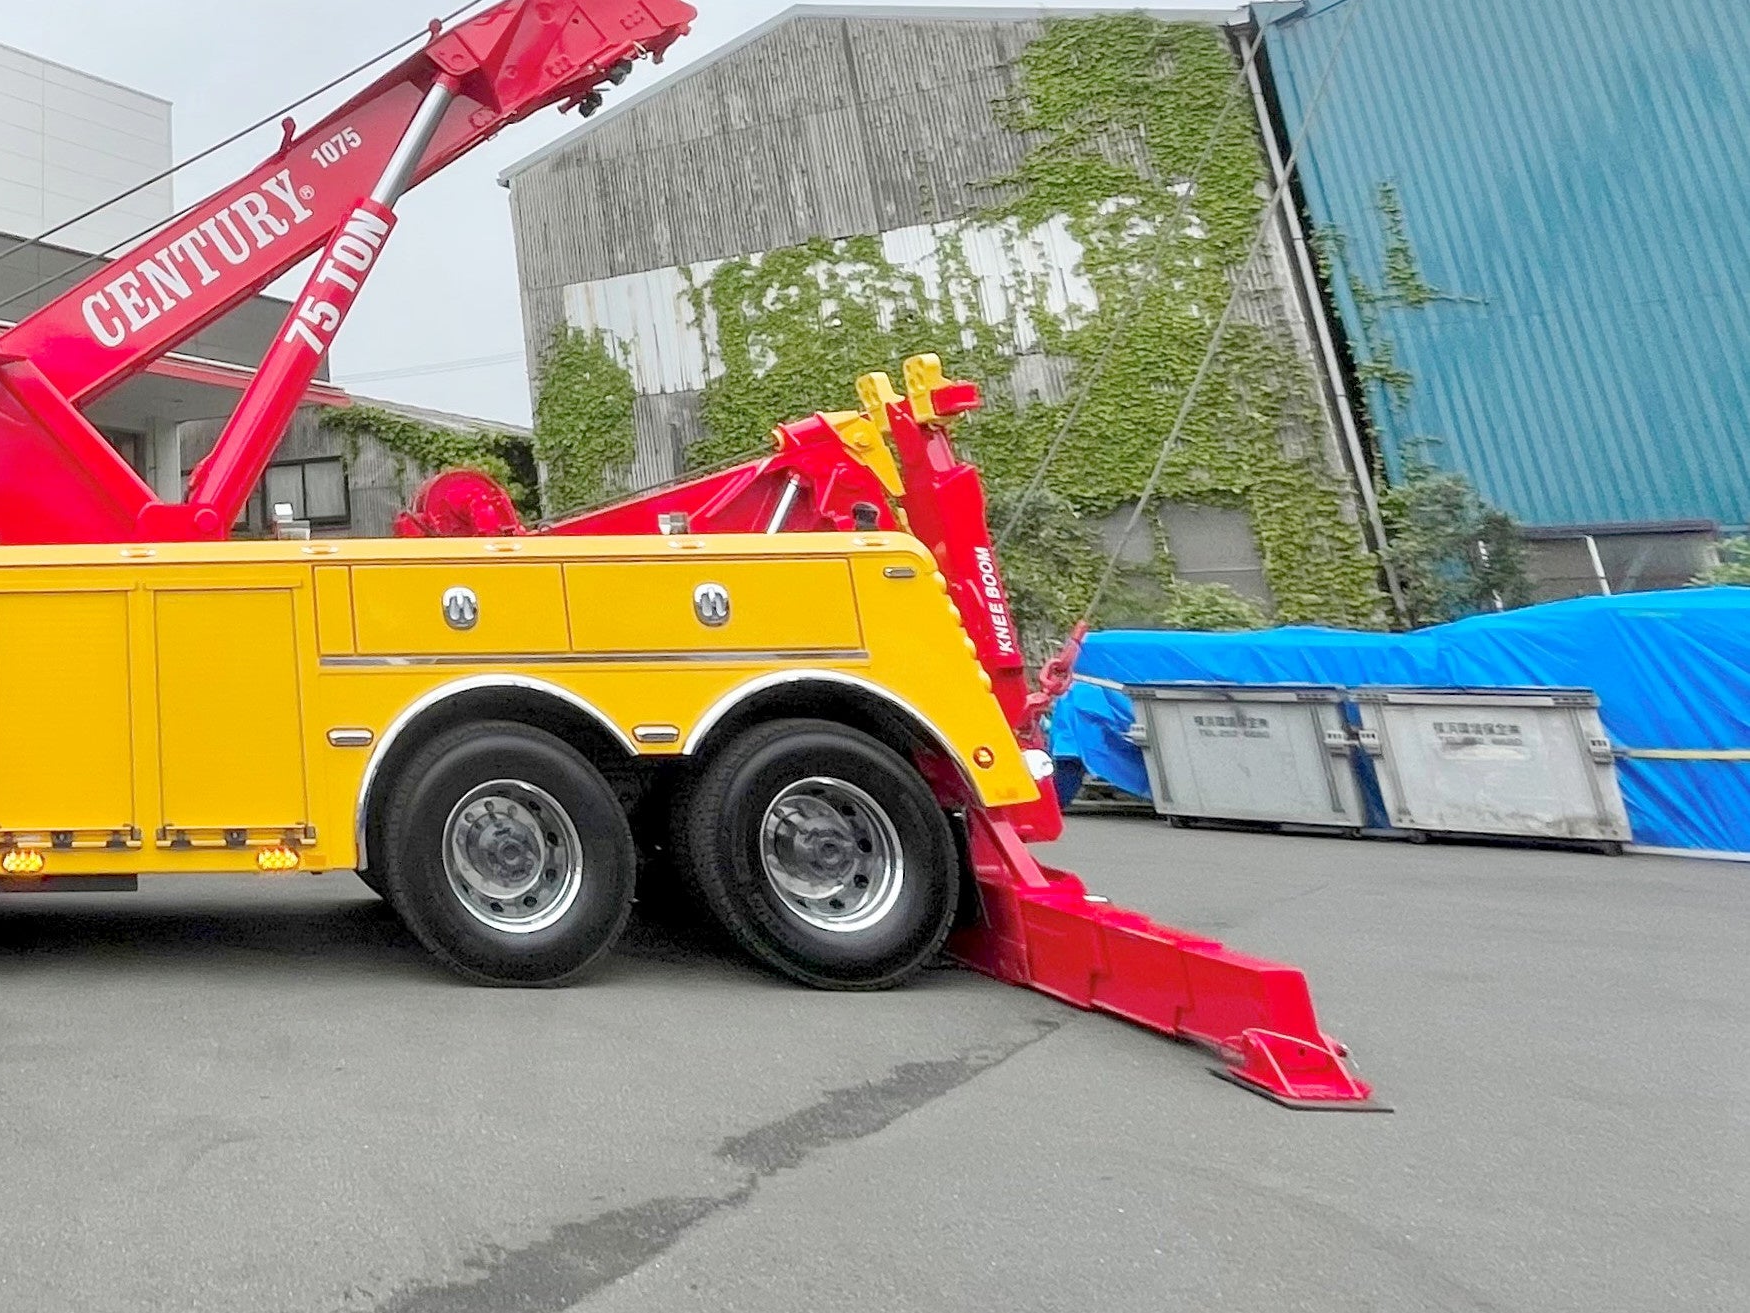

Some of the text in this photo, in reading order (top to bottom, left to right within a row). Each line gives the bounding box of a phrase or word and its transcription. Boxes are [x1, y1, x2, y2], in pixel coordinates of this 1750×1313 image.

[311, 126, 362, 168] 1075
[283, 208, 389, 355] 75 TON
[974, 546, 1014, 653] KNEE BOOM
